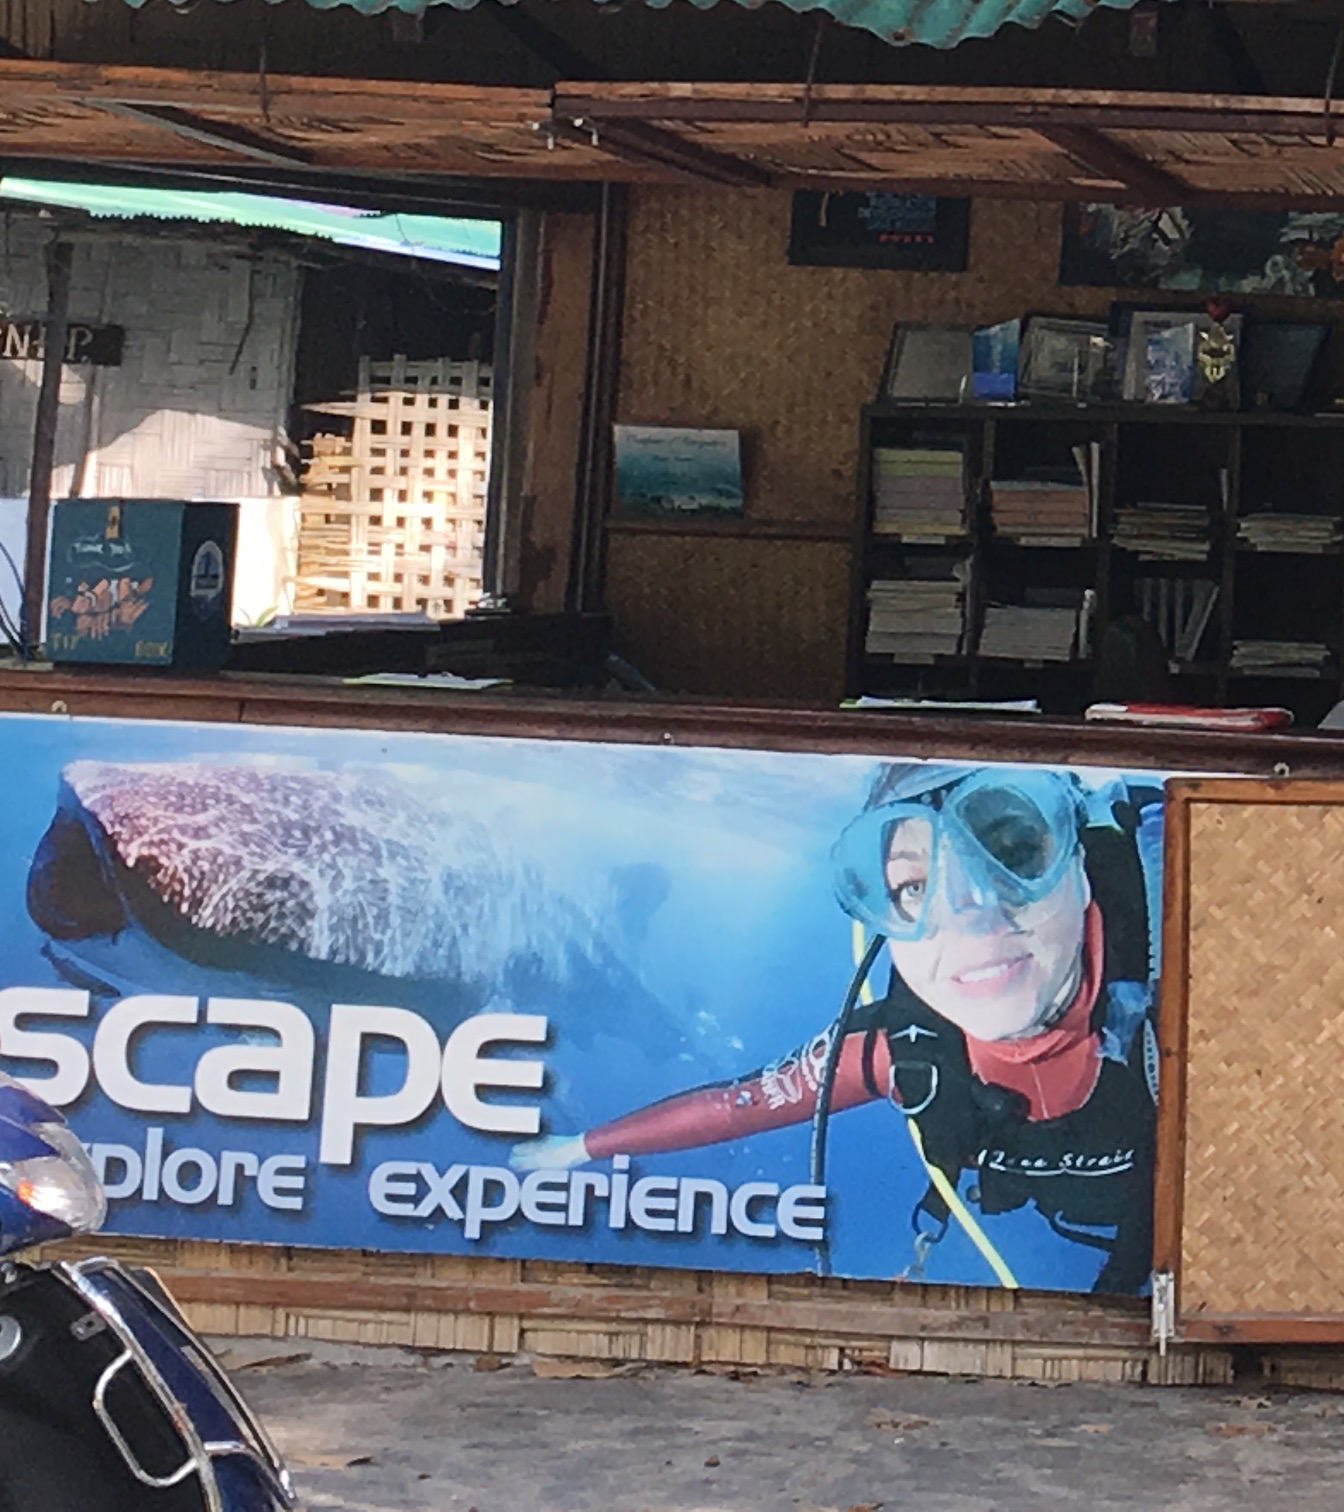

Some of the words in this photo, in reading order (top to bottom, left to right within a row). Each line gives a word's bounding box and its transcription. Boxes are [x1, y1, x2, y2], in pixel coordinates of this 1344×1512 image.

[0, 985, 548, 1166] scape
[82, 1126, 307, 1211] plore
[369, 1152, 827, 1241] experience
